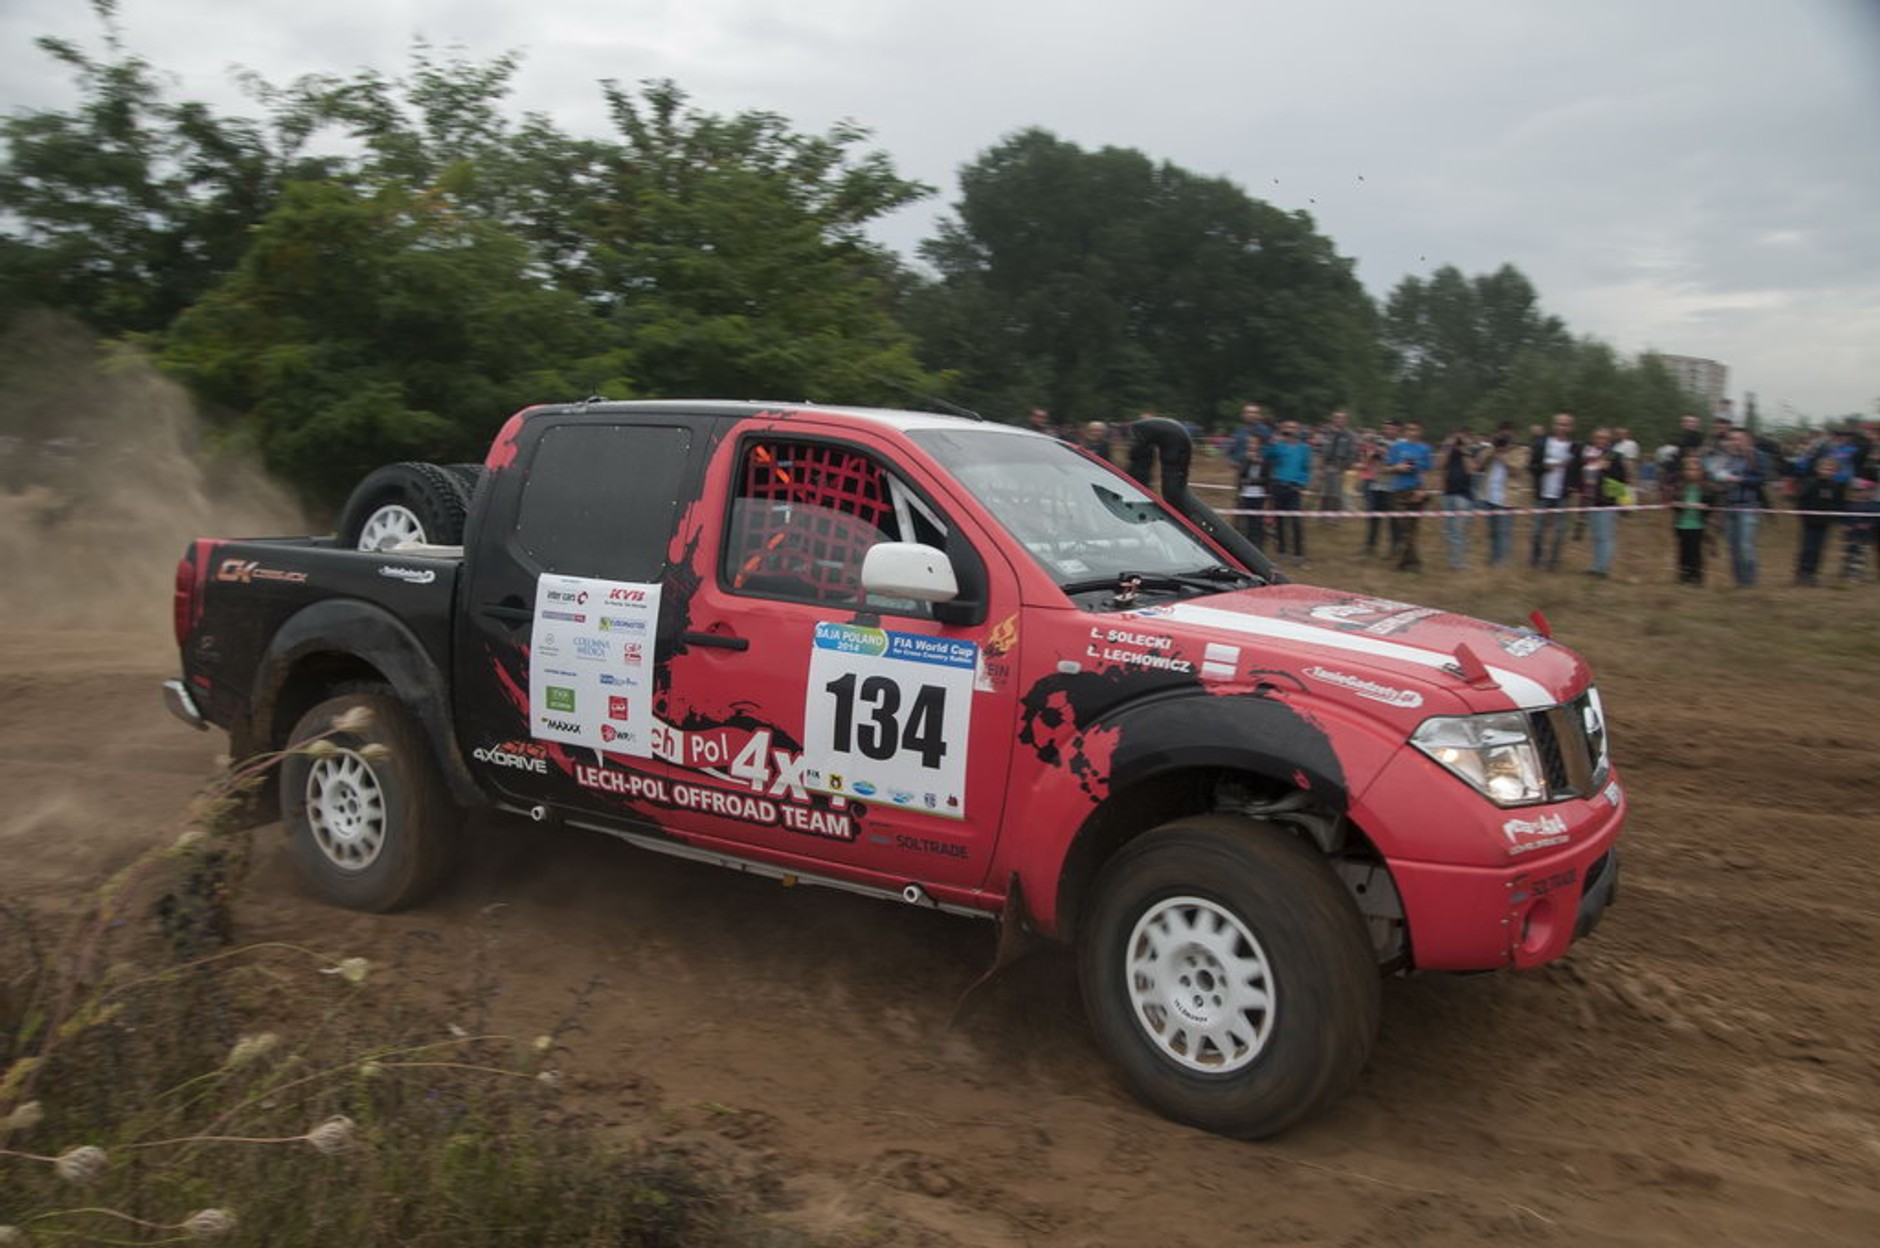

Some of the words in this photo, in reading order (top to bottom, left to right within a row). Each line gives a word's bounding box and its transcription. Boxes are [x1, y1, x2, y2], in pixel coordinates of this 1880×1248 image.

[609, 588, 646, 602] KYB
[815, 627, 840, 640] BAJA
[842, 629, 884, 647] POLAND
[893, 637, 913, 650] FIA
[915, 638, 949, 653] World
[951, 644, 973, 658] Cup
[1107, 629, 1172, 650] SOLECKI
[1103, 648, 1192, 673] LECHOWICZ
[825, 672, 947, 770] 134
[691, 732, 728, 764] Pol
[576, 765, 670, 801] LECH-POL
[673, 785, 776, 823] OFFROAD
[782, 805, 851, 837] TEAM
[896, 834, 970, 859] SOLTRADE
